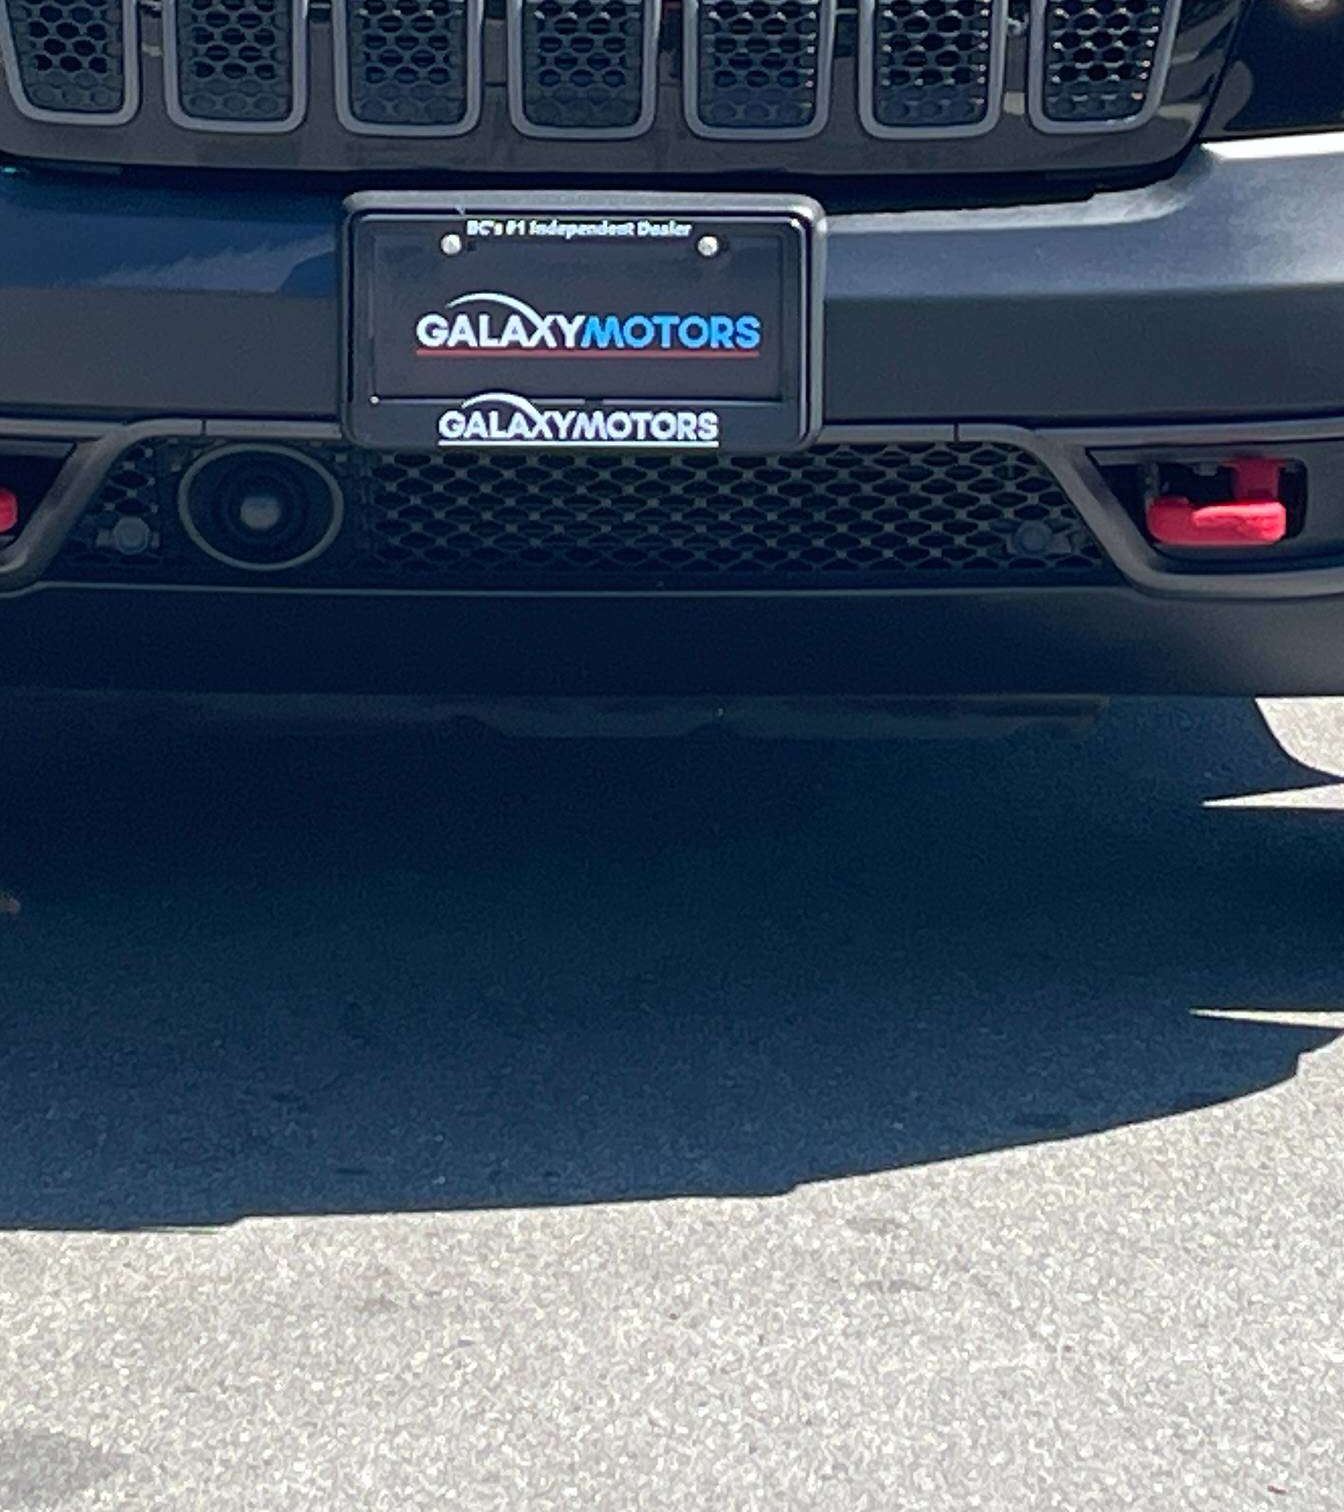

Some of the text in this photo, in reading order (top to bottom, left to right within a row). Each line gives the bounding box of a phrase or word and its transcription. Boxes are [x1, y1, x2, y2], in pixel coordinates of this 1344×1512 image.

[528, 219, 635, 240] Independent
[636, 219, 692, 237] Dealer
[439, 410, 718, 442] GALAXYMOTORS
